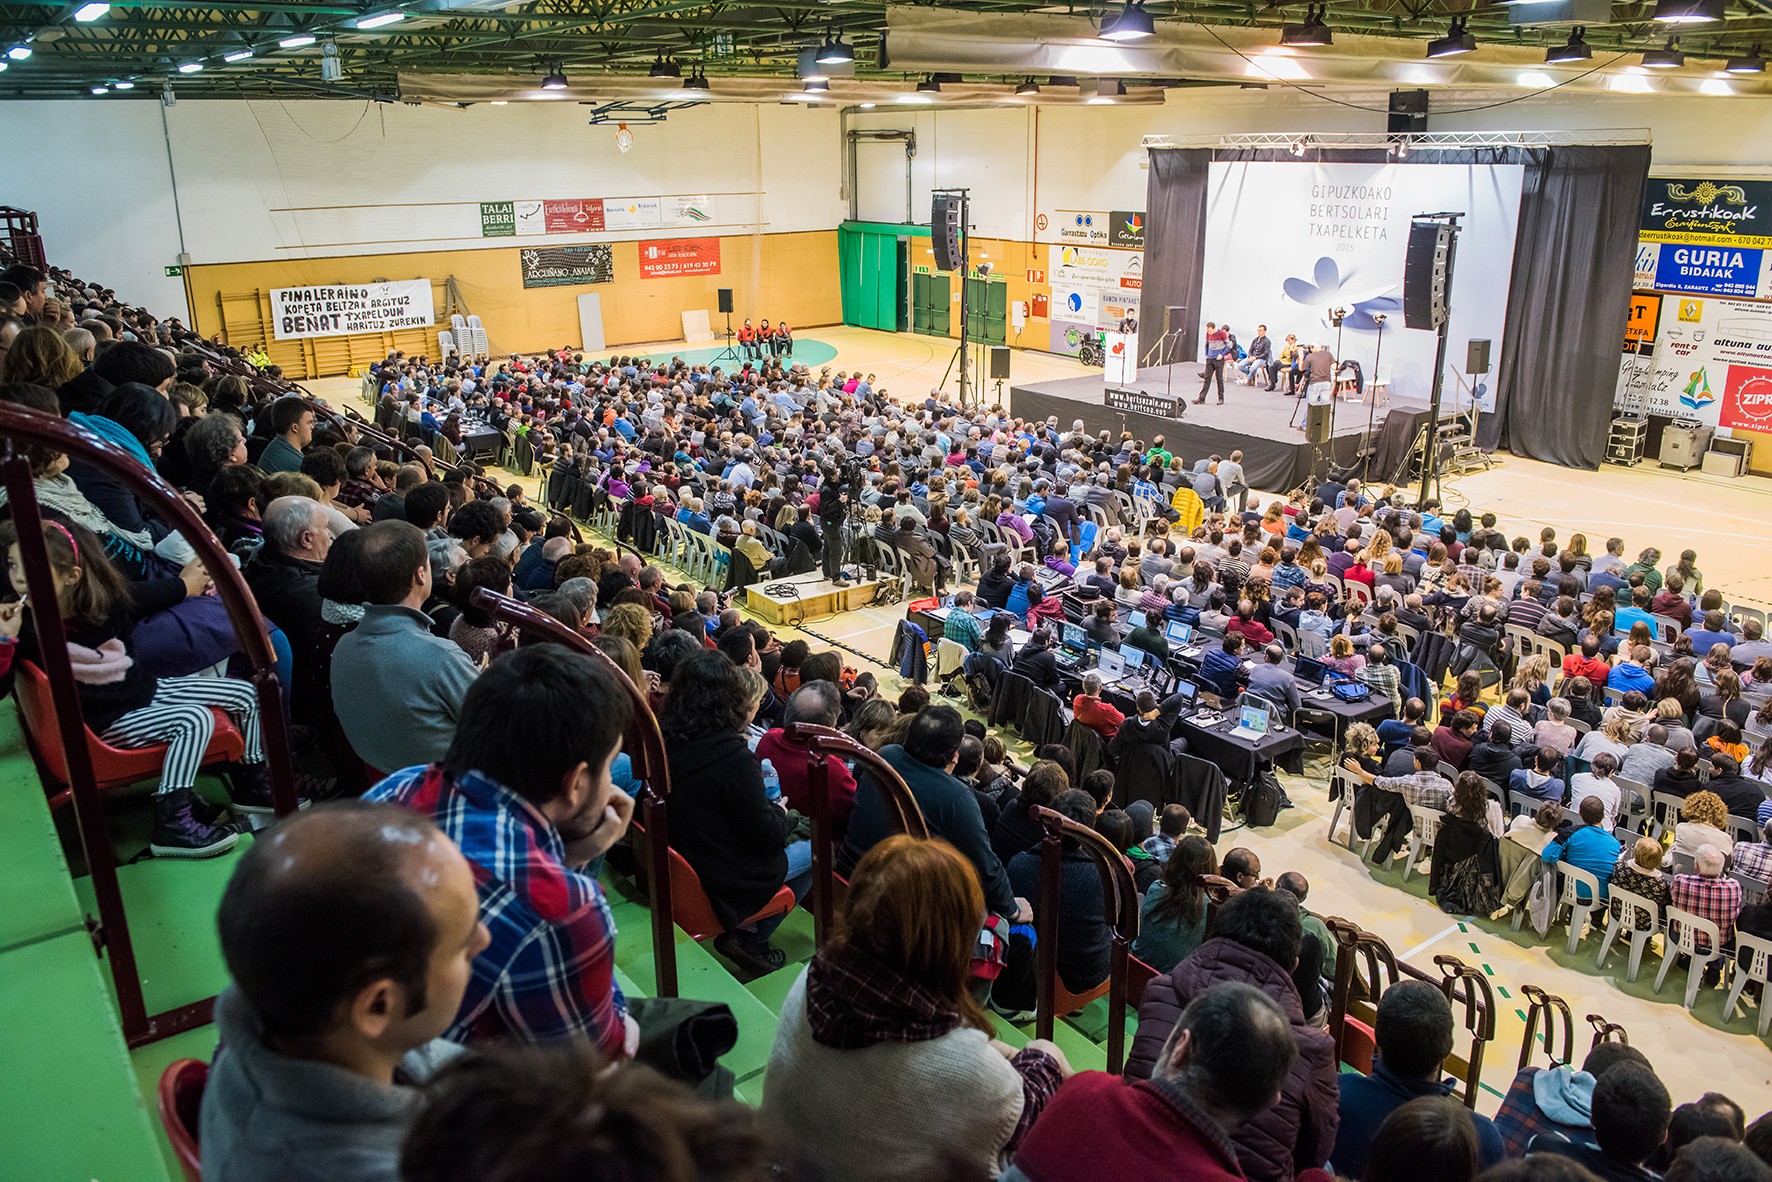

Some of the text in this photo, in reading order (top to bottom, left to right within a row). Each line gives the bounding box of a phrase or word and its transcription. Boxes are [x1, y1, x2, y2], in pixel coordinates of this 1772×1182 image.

[1312, 185, 1392, 200] GIPUZKOAKO
[482, 204, 512, 214] TALAI
[1310, 204, 1388, 220] BERTSOLARI
[483, 214, 514, 224] BERRI
[1061, 228, 1087, 238] Garrastazu
[1090, 230, 1107, 239] Optika
[1309, 223, 1387, 240] TXAPELKETA
[1752, 238, 1765, 246] 042
[1674, 248, 1744, 269] GURIA
[1680, 266, 1733, 279] BIDAIAK
[285, 296, 410, 315] KOPETA BELTZAK ARGITUZ
[1103, 295, 1117, 303] RAMON
[345, 307, 404, 321] TXAPELDUN
[282, 312, 341, 333] BEÑAT
[346, 316, 426, 331] HARITUZ ZUREKIN
[1670, 341, 1690, 350] rent
[1714, 338, 1753, 350] altuna
[1109, 392, 1172, 410] www.bertsozale.eus
[1113, 401, 1167, 416] www.bertsoa.eus
